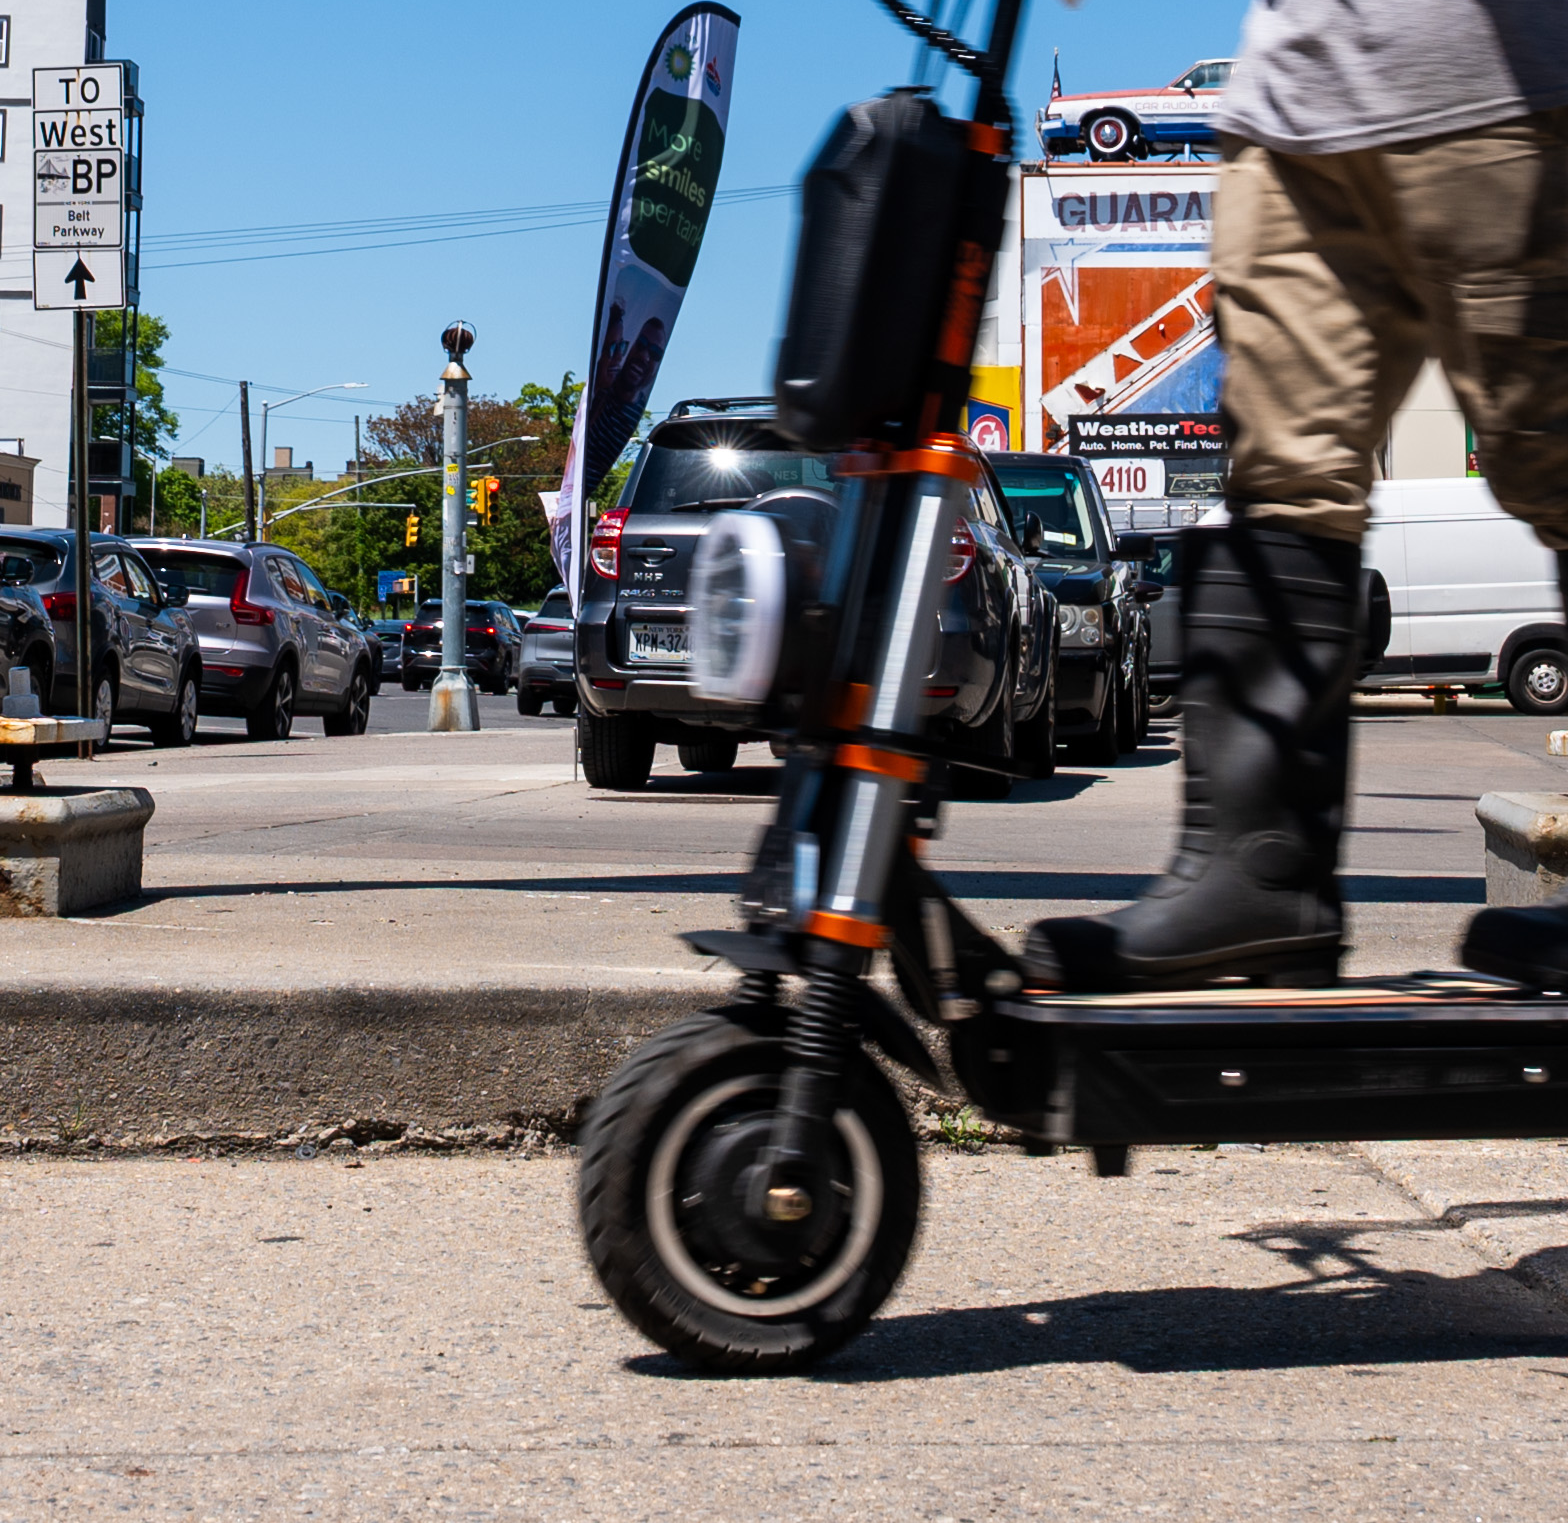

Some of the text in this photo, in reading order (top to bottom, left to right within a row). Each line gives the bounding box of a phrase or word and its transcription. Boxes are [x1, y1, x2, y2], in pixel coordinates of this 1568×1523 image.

[59, 77, 100, 104] TO
[1135, 102, 1159, 111] CAR
[1163, 102, 1198, 110] AUDIO
[40, 119, 117, 148] West
[648, 118, 703, 162] More
[72, 158, 117, 195] BP
[645, 160, 705, 208] smiles
[68, 210, 90, 222] Belt
[639, 196, 675, 227] per
[1058, 191, 1215, 232] GUARA
[53, 226, 104, 239] Parkway
[1079, 440, 1223, 451] Auto. Home. Pet. Find Your
[1100, 466, 1147, 493] 4110
